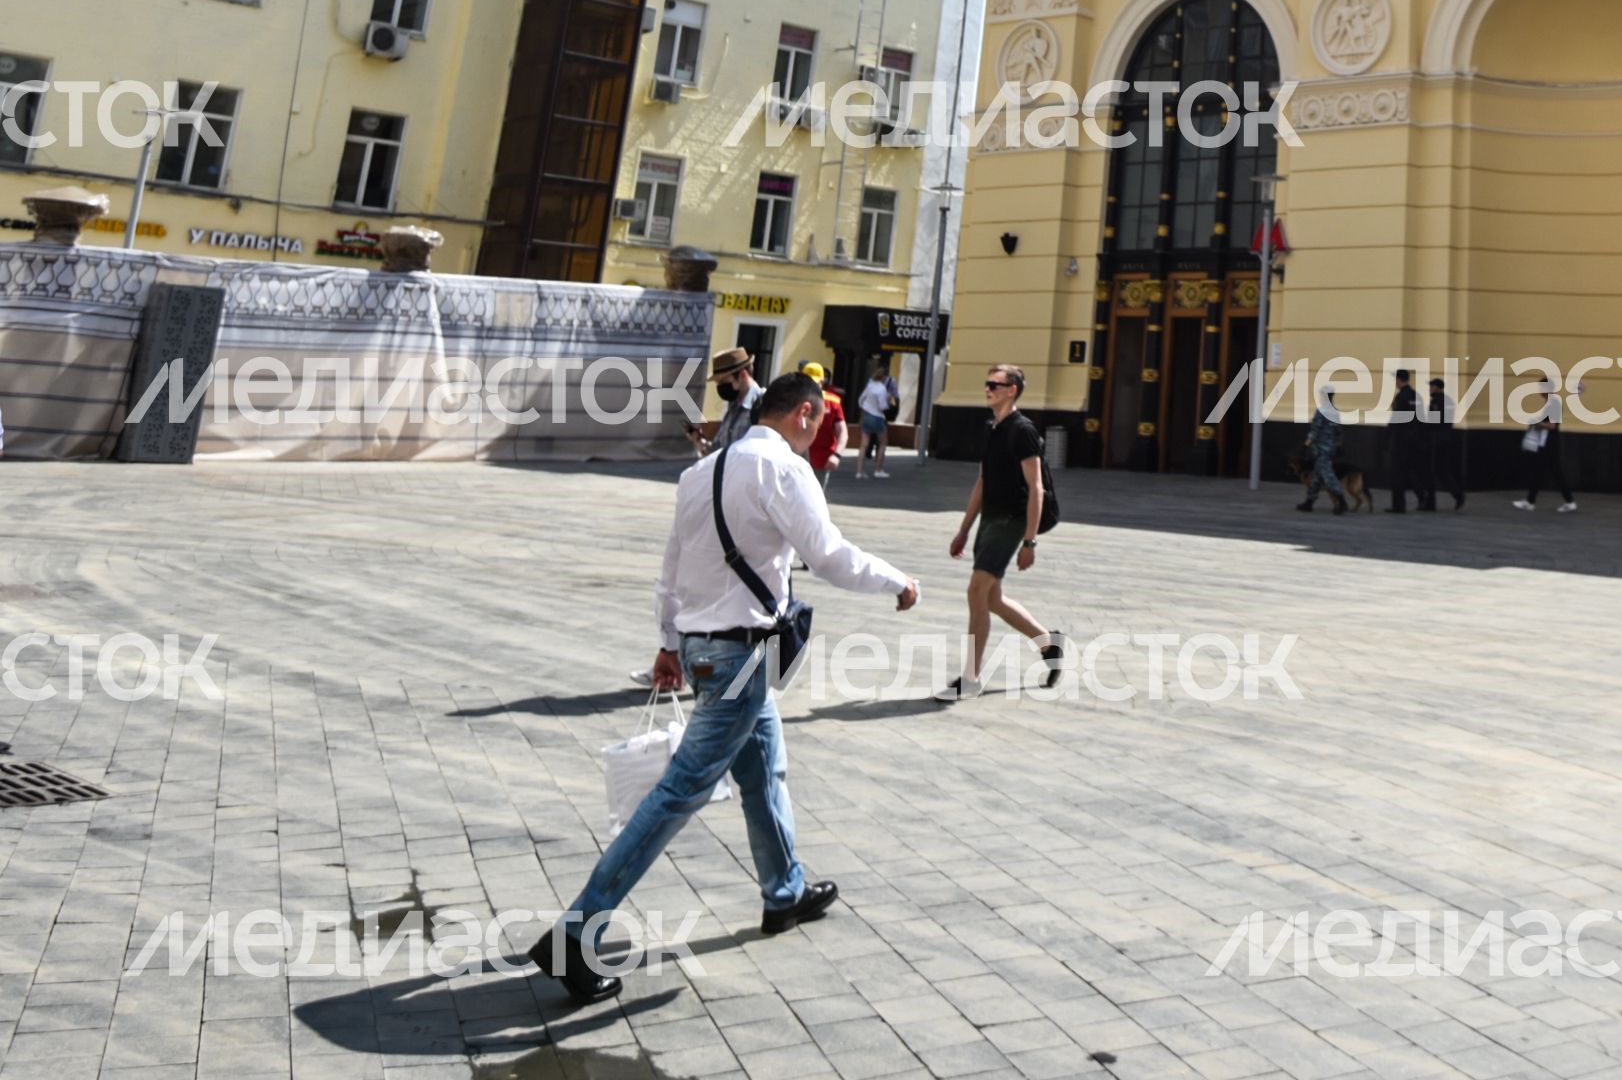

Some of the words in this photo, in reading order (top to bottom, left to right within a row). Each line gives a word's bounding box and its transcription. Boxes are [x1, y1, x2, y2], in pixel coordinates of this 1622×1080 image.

[190, 228, 205, 245] У
[209, 231, 304, 254] ПАЛЫЧА
[723, 293, 790, 314] BAKERY
